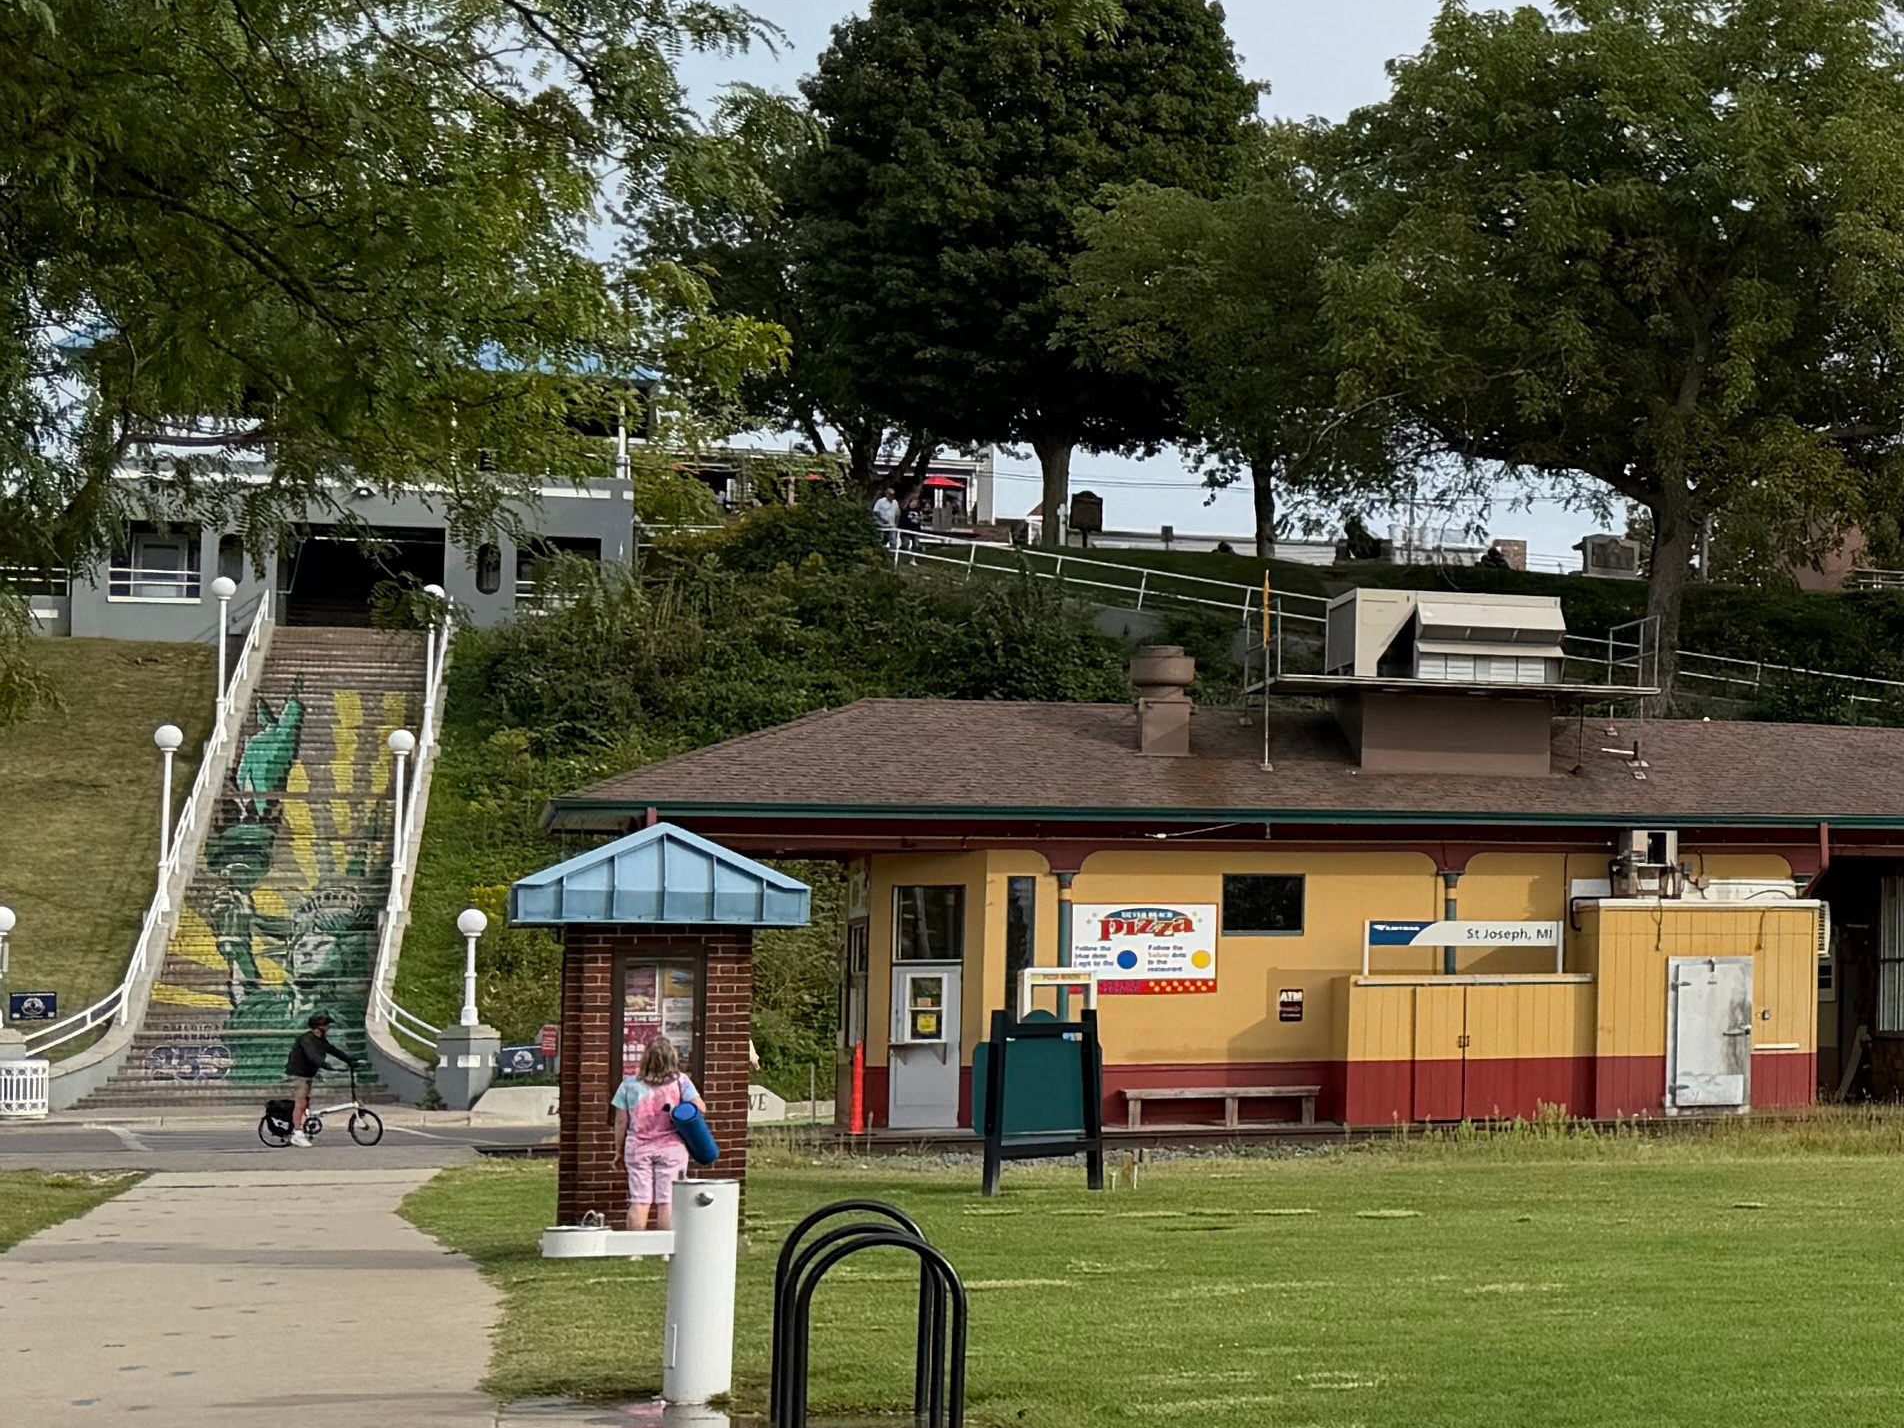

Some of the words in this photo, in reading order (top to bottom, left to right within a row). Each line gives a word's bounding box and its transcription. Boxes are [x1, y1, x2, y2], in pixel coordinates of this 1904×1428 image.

[1466, 928, 1480, 939] St
[1483, 928, 1532, 942] Joseph,
[1536, 928, 1553, 939] MI
[1280, 991, 1303, 1002] ATM
